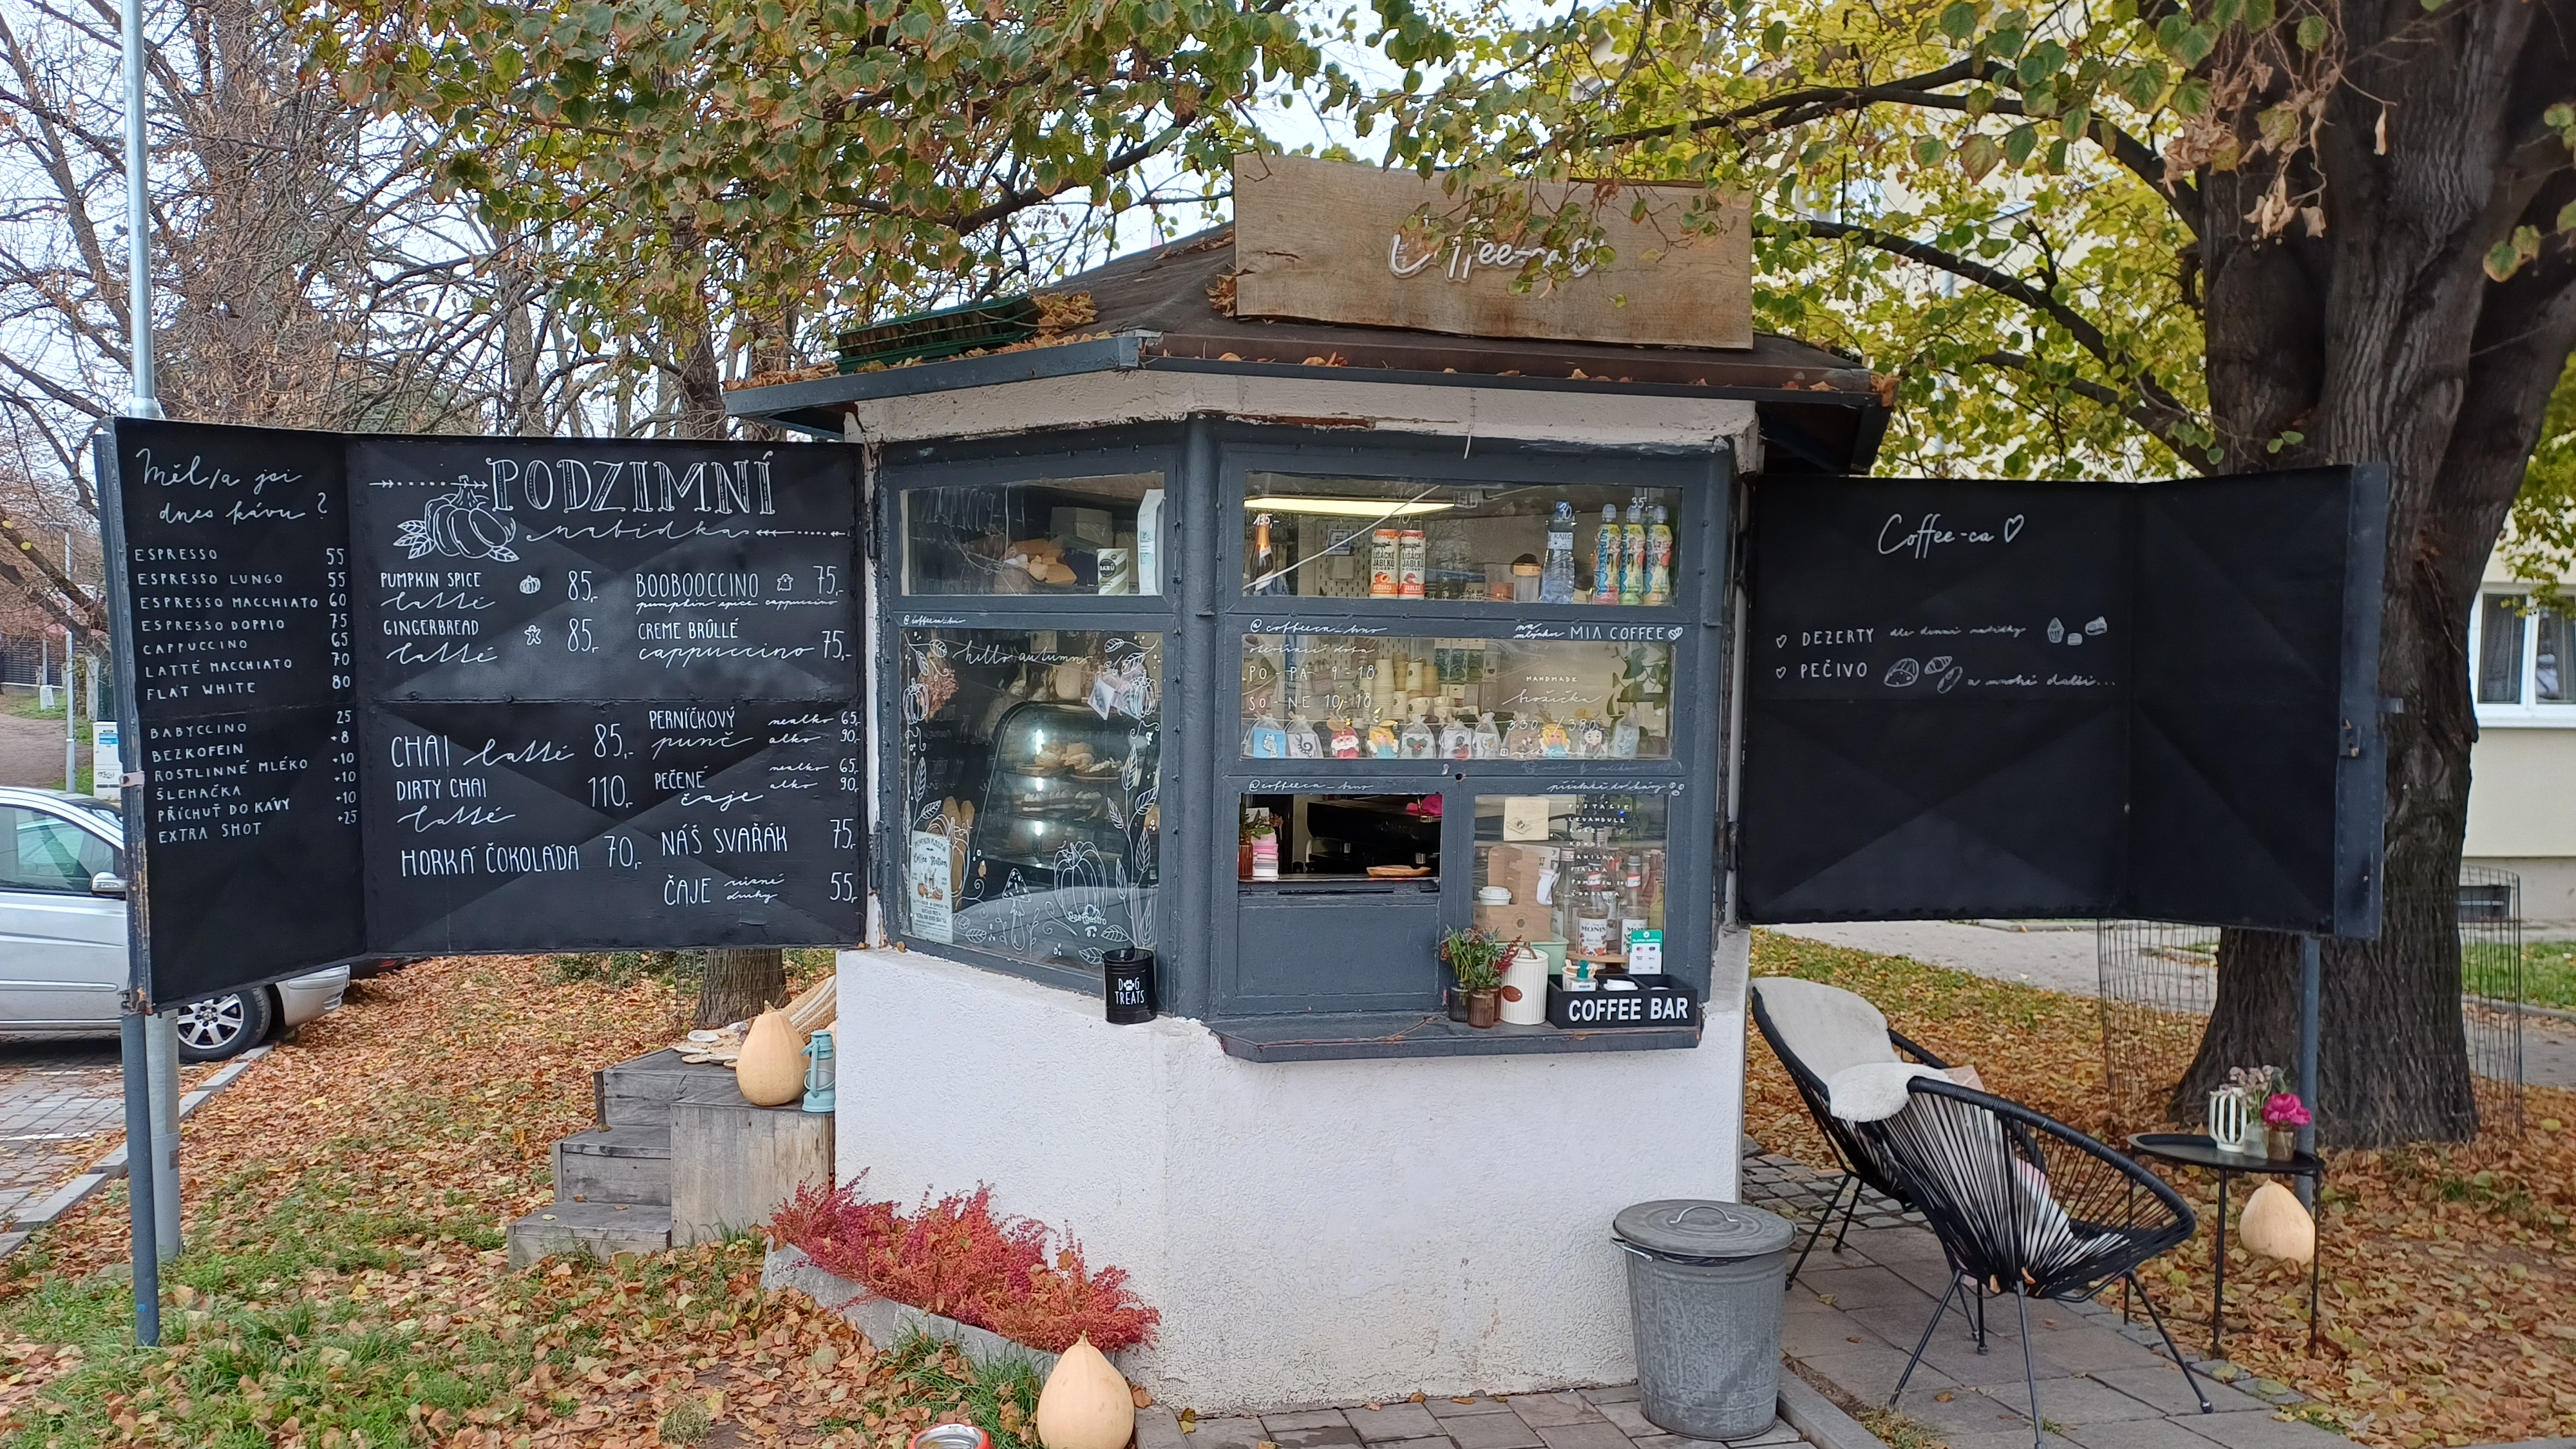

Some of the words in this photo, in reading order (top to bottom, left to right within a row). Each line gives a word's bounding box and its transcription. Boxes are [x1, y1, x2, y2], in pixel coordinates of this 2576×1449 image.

[136, 448, 240, 489] Měl/a
[254, 469, 303, 495] jsi
[486, 451, 775, 515] PODZIMNÍ
[160, 503, 213, 524] dnes
[1878, 513, 1995, 559] Coffee-ca
[135, 549, 217, 562] ESPRESSO
[327, 548, 345, 565] 55
[138, 573, 218, 585] ESPRESSO
[230, 574, 283, 585] LUNGO
[328, 572, 346, 587] 55
[381, 572, 439, 587] PUMPKIN
[447, 572, 482, 587] SPICE
[636, 573, 759, 598] BOOBOOCCINO
[140, 597, 223, 609] ESPRESSO
[232, 598, 318, 608] MACCHIATO
[329, 593, 346, 607] 60
[636, 598, 716, 615] pumpkin
[717, 599, 759, 611] spice
[764, 598, 838, 611] cappuccino
[141, 620, 223, 632] ESPRESSO
[231, 620, 285, 630] DOPPIO
[329, 613, 348, 629] 75
[383, 619, 478, 636] GINGERBREAD
[638, 622, 681, 639] CREME
[688, 618, 739, 639] BRÛLLÉ
[1570, 627, 1602, 640] MIA
[1610, 627, 1665, 640] COFFEE
[143, 639, 247, 655] CAPPUCCINO
[331, 632, 348, 647] 65
[1803, 627, 1875, 646] DEZERTY
[638, 642, 815, 668] cappuccino
[952, 639, 1013, 665] hello
[1019, 646, 1094, 665] autumn
[146, 660, 202, 677] LATTÉ
[209, 659, 292, 672] MACCHIATO
[330, 652, 350, 666] 70
[1249, 665, 1267, 682] PO
[1358, 665, 1376, 681] 18
[1801, 658, 1868, 678] PEČIVO
[147, 685, 189, 700] FLAT
[202, 683, 256, 695] WHITE
[332, 675, 350, 689] 80
[1249, 696, 1266, 711] SO
[1288, 695, 1311, 708] NE
[1356, 692, 1372, 709] 18
[150, 723, 247, 739] BABYCCINO
[336, 710, 352, 724] 25
[649, 706, 736, 730] PERNÍČKOVÝ
[151, 743, 243, 762] BEZKOFEIN
[391, 735, 449, 767] CHAI
[651, 731, 755, 761] punč
[768, 734, 822, 744] alko
[155, 760, 250, 782] ROSTLINNÉ
[258, 755, 308, 772] MLÉKO
[655, 765, 709, 791] PEČENÉ
[156, 784, 242, 800] ŠLEHAČKA
[396, 778, 442, 801] DIRTY
[450, 777, 488, 799] CHAI
[681, 790, 764, 811] čaje
[770, 779, 819, 790] alko
[158, 803, 221, 822] PŘÍCHUŤ
[229, 803, 248, 815] DO
[254, 797, 290, 813] KÁVY
[1569, 800, 1630, 810] PISTÁCIE
[158, 826, 208, 844] EXTRA
[222, 822, 261, 837] SHOT
[661, 823, 703, 857] NÁŠ
[712, 822, 788, 854] SVAŘÁK
[401, 845, 477, 876] HORKÁ
[485, 841, 580, 873] ČOKOLÁDA
[664, 874, 712, 906] ČAJE
[1114, 989, 1145, 1005] TREATS
[1567, 998, 1642, 1022] COFFEE
[1649, 997, 1689, 1020] BAR
